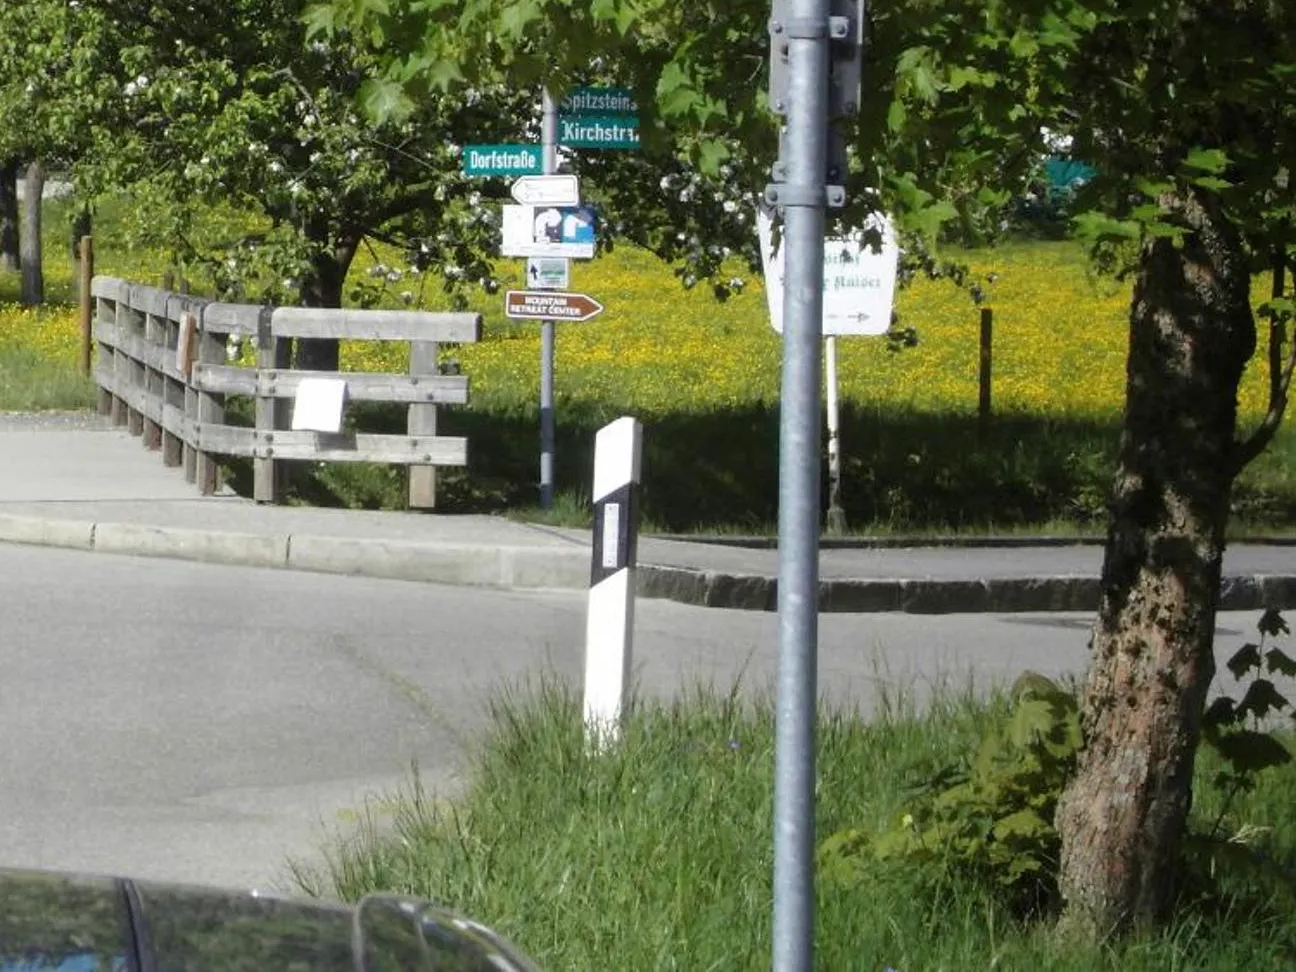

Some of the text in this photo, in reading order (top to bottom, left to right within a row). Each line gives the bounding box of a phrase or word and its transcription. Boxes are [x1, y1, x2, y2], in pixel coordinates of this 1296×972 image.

[470, 149, 536, 169] Dorfstraße
[510, 304, 581, 316] RETREAT CENTER
